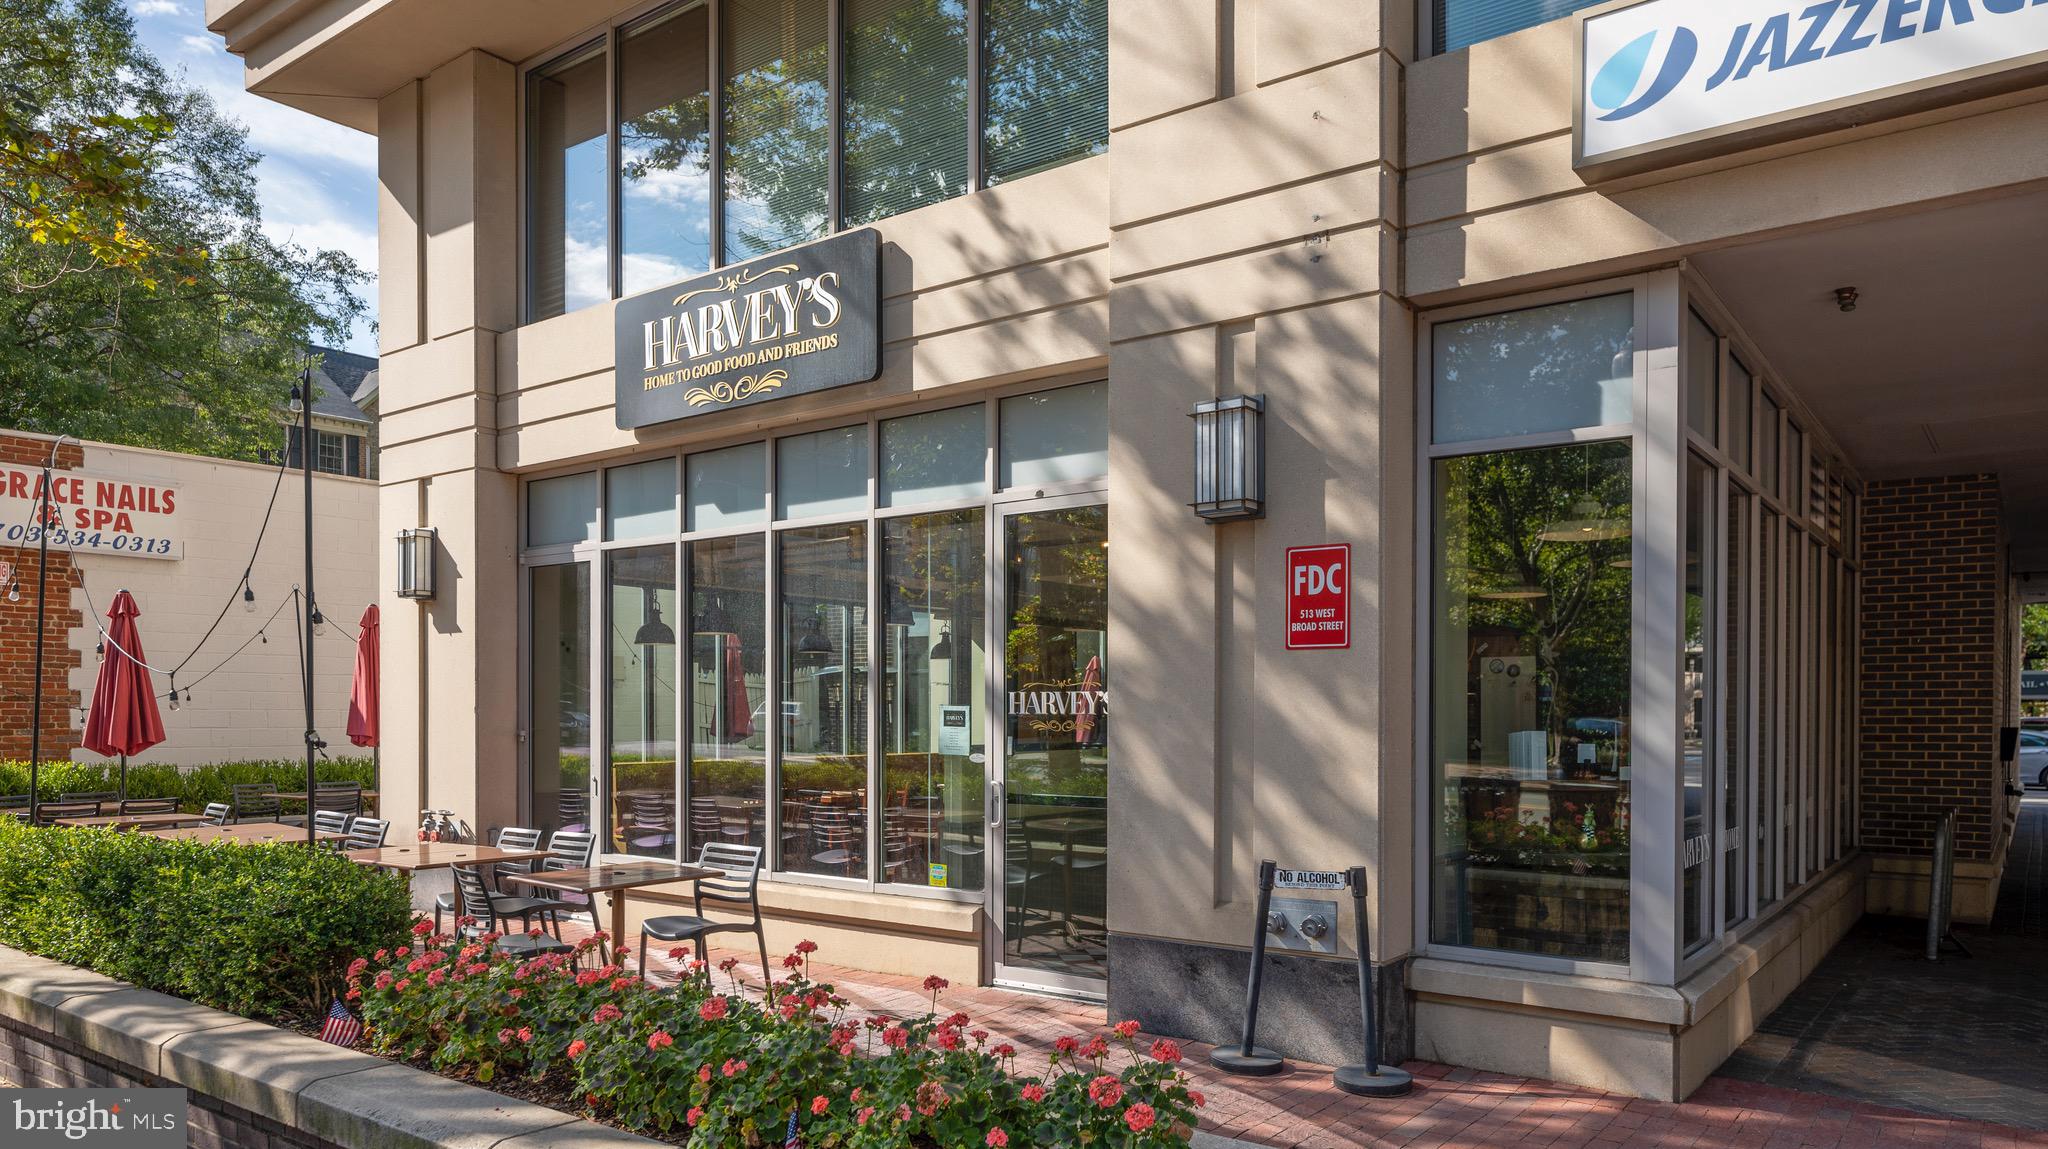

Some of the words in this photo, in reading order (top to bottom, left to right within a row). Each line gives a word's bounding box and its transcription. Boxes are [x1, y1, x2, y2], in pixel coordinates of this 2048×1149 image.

[1705, 0, 2048, 92] JAZZE
[643, 271, 841, 371] HARVEY'S
[644, 373, 675, 391] HOME
[677, 368, 691, 383] TO
[692, 360, 722, 380] GOOD
[724, 352, 756, 372] FOOD
[756, 346, 783, 365] AND
[783, 334, 839, 359] FRIENDS
[97, 481, 175, 515] NAILS
[75, 508, 134, 533] SPA
[0, 523, 171, 554] 03534-0313
[1294, 563, 1342, 596] FDC
[1291, 622, 1317, 632] BROAD
[1318, 621, 1344, 631] STREET
[1300, 609, 1314, 619] 513
[1315, 608, 1335, 618] WEST
[1280, 872, 1293, 882] NO
[1297, 872, 1340, 884] ALCOHOL
